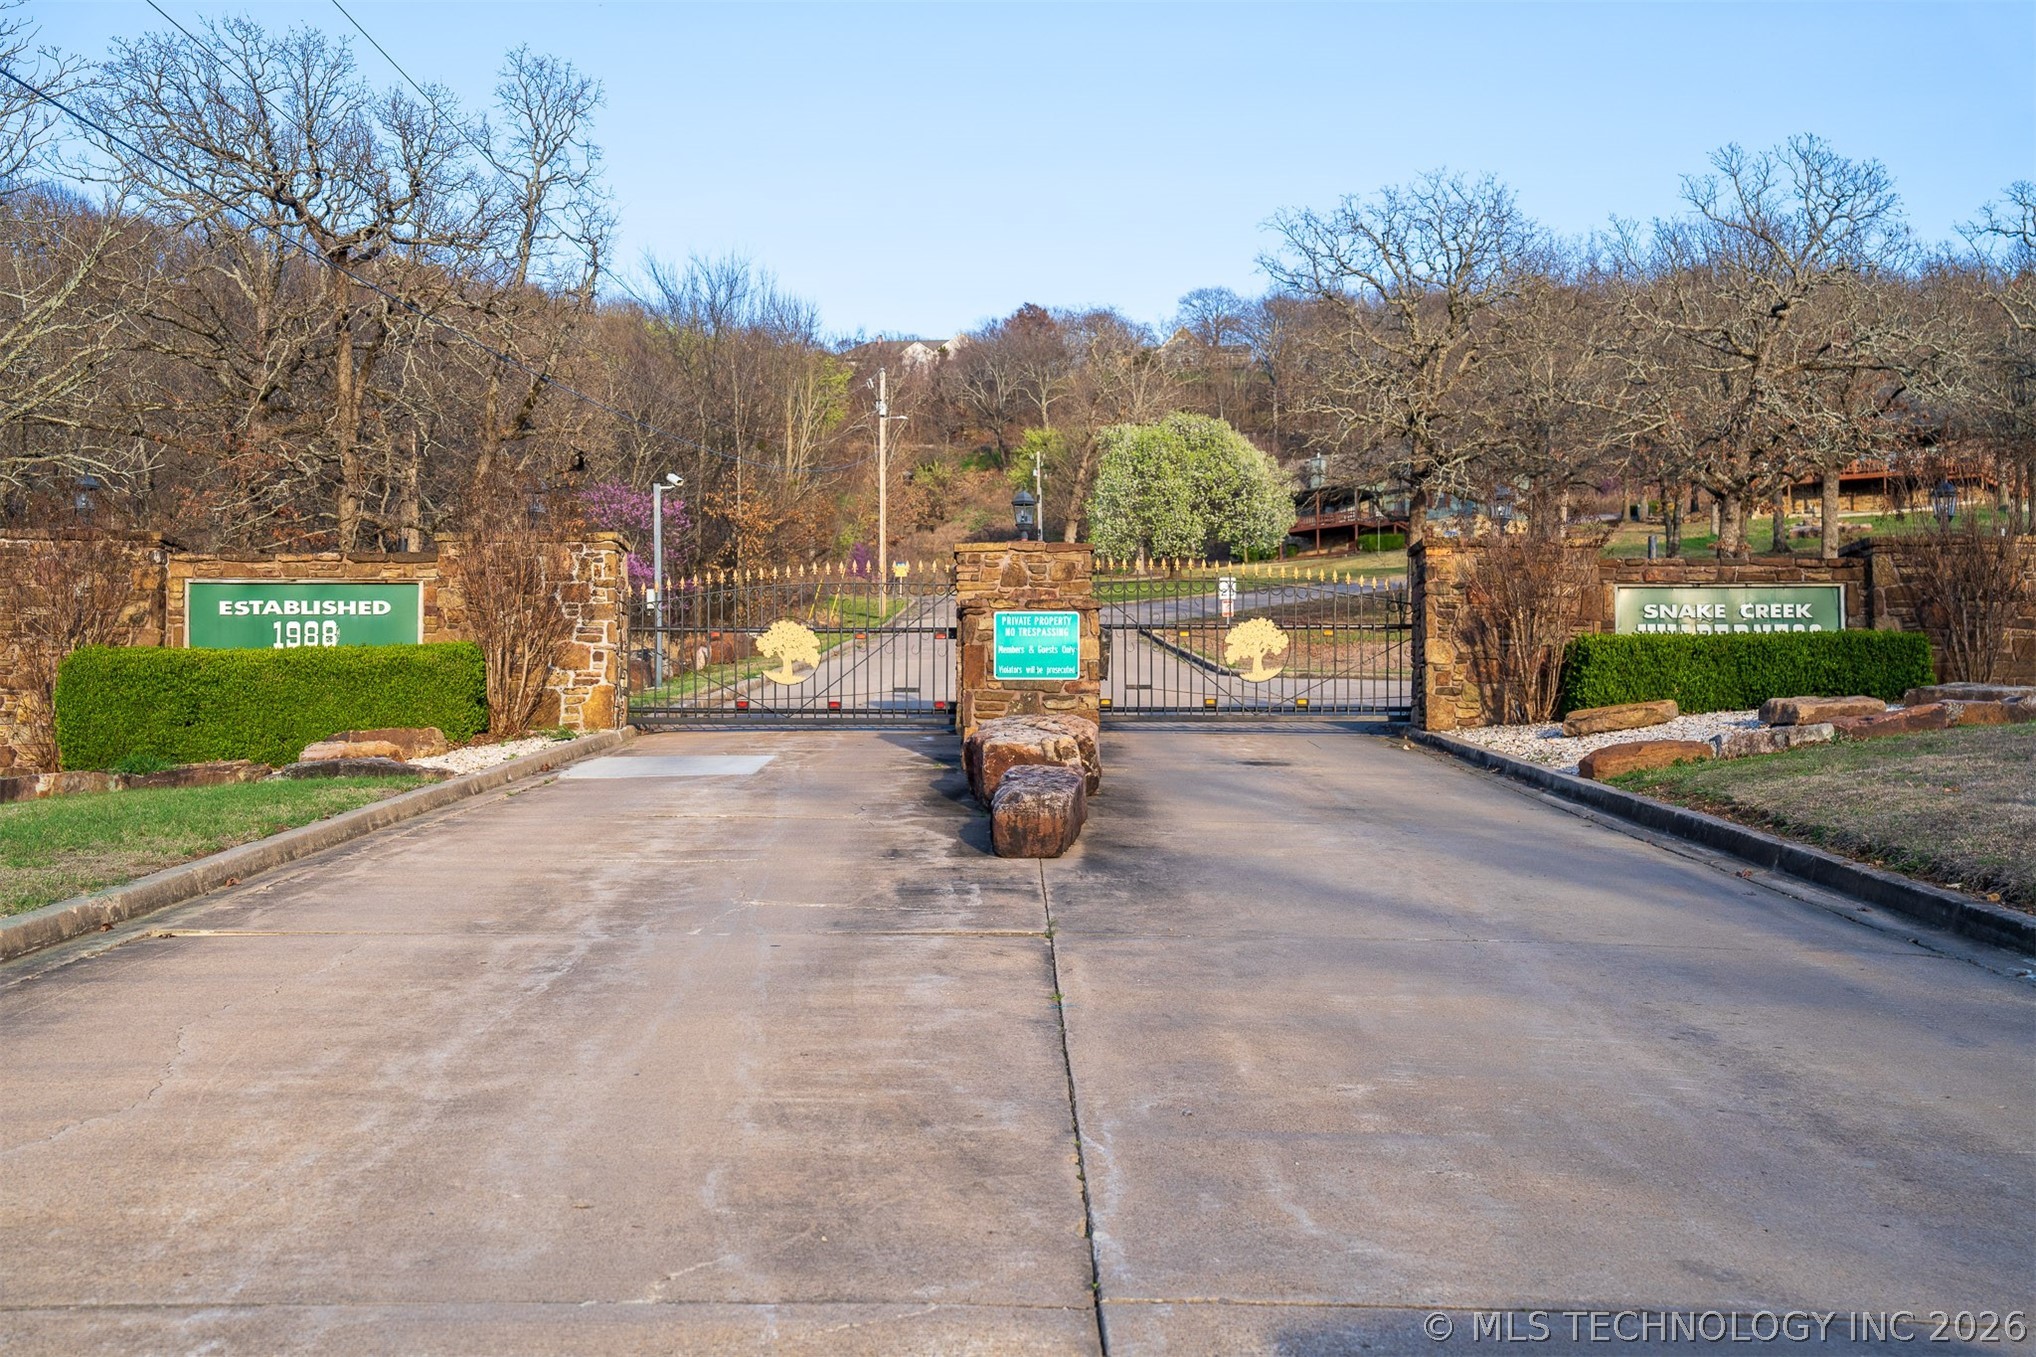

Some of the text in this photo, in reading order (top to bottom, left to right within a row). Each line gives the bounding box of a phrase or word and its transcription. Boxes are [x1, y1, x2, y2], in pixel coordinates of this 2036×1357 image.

[219, 600, 391, 616] ESTABLISHED
[1643, 603, 1812, 619] SNAKE CREEK
[1001, 616, 1072, 625] PRIVATE PROPERTY
[273, 619, 339, 649] 1988
[1005, 627, 1069, 636] NO TRESPASSING
[998, 645, 1076, 655] Members & Guests Only
[999, 666, 1076, 675] Violators will be prosecuted
